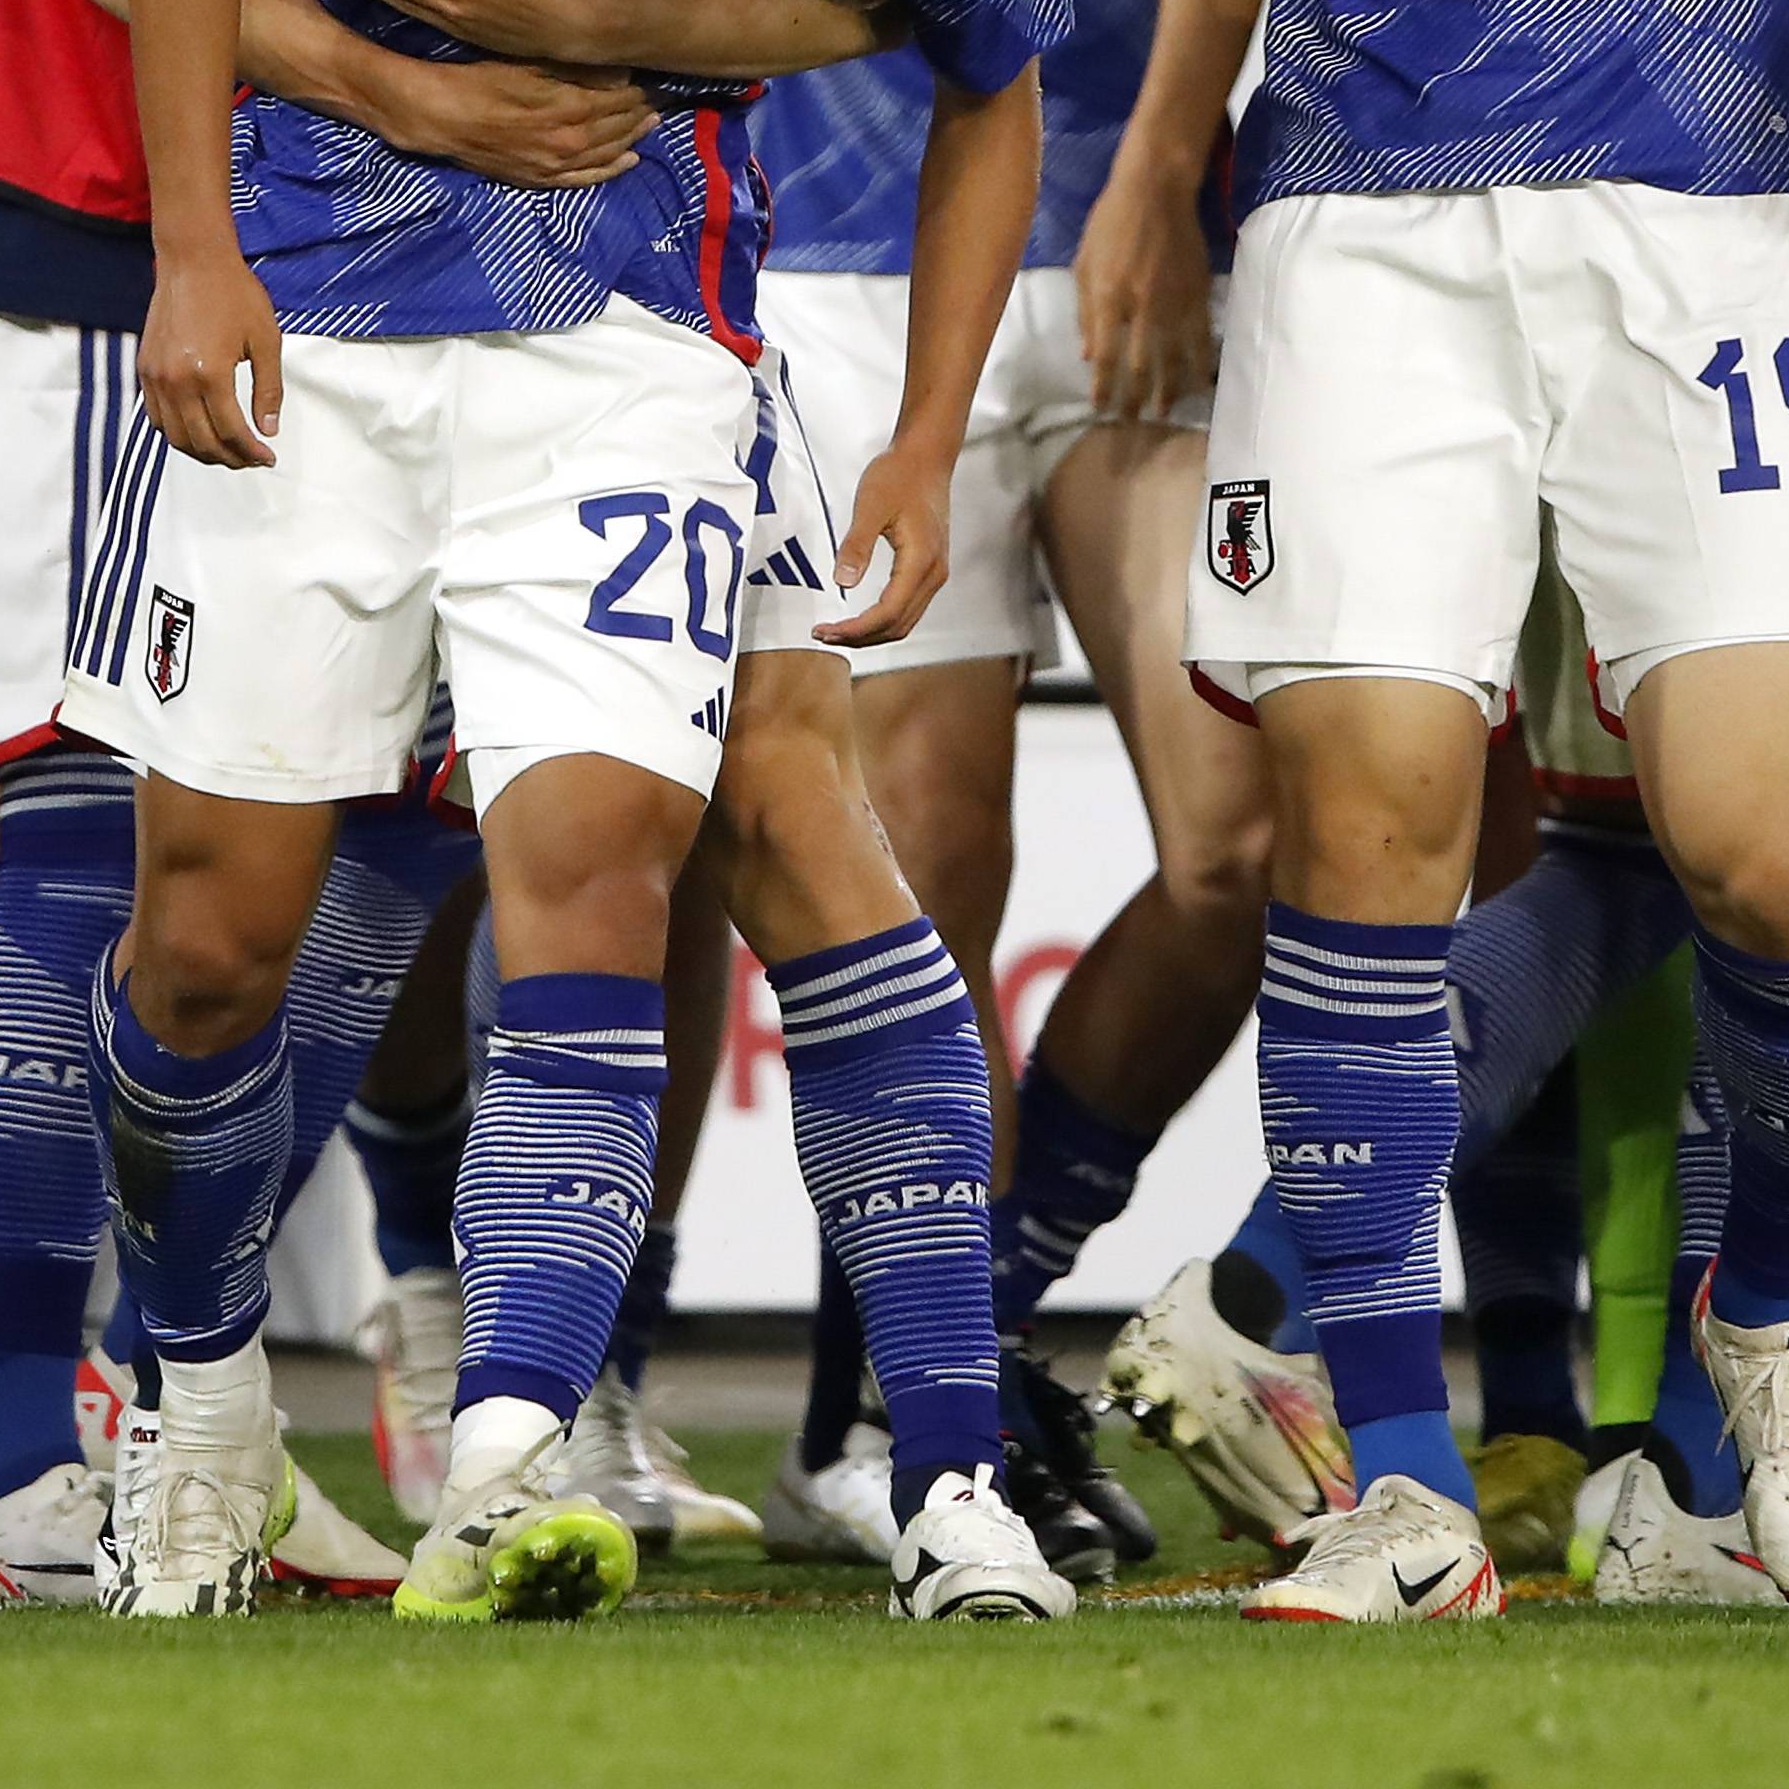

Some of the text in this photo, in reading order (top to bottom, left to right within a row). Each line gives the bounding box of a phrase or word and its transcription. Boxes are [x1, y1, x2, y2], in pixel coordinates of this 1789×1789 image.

[1222, 483, 1256, 495] JAPAN
[578, 492, 743, 660] 20
[1267, 1142, 1373, 1165] PAN
